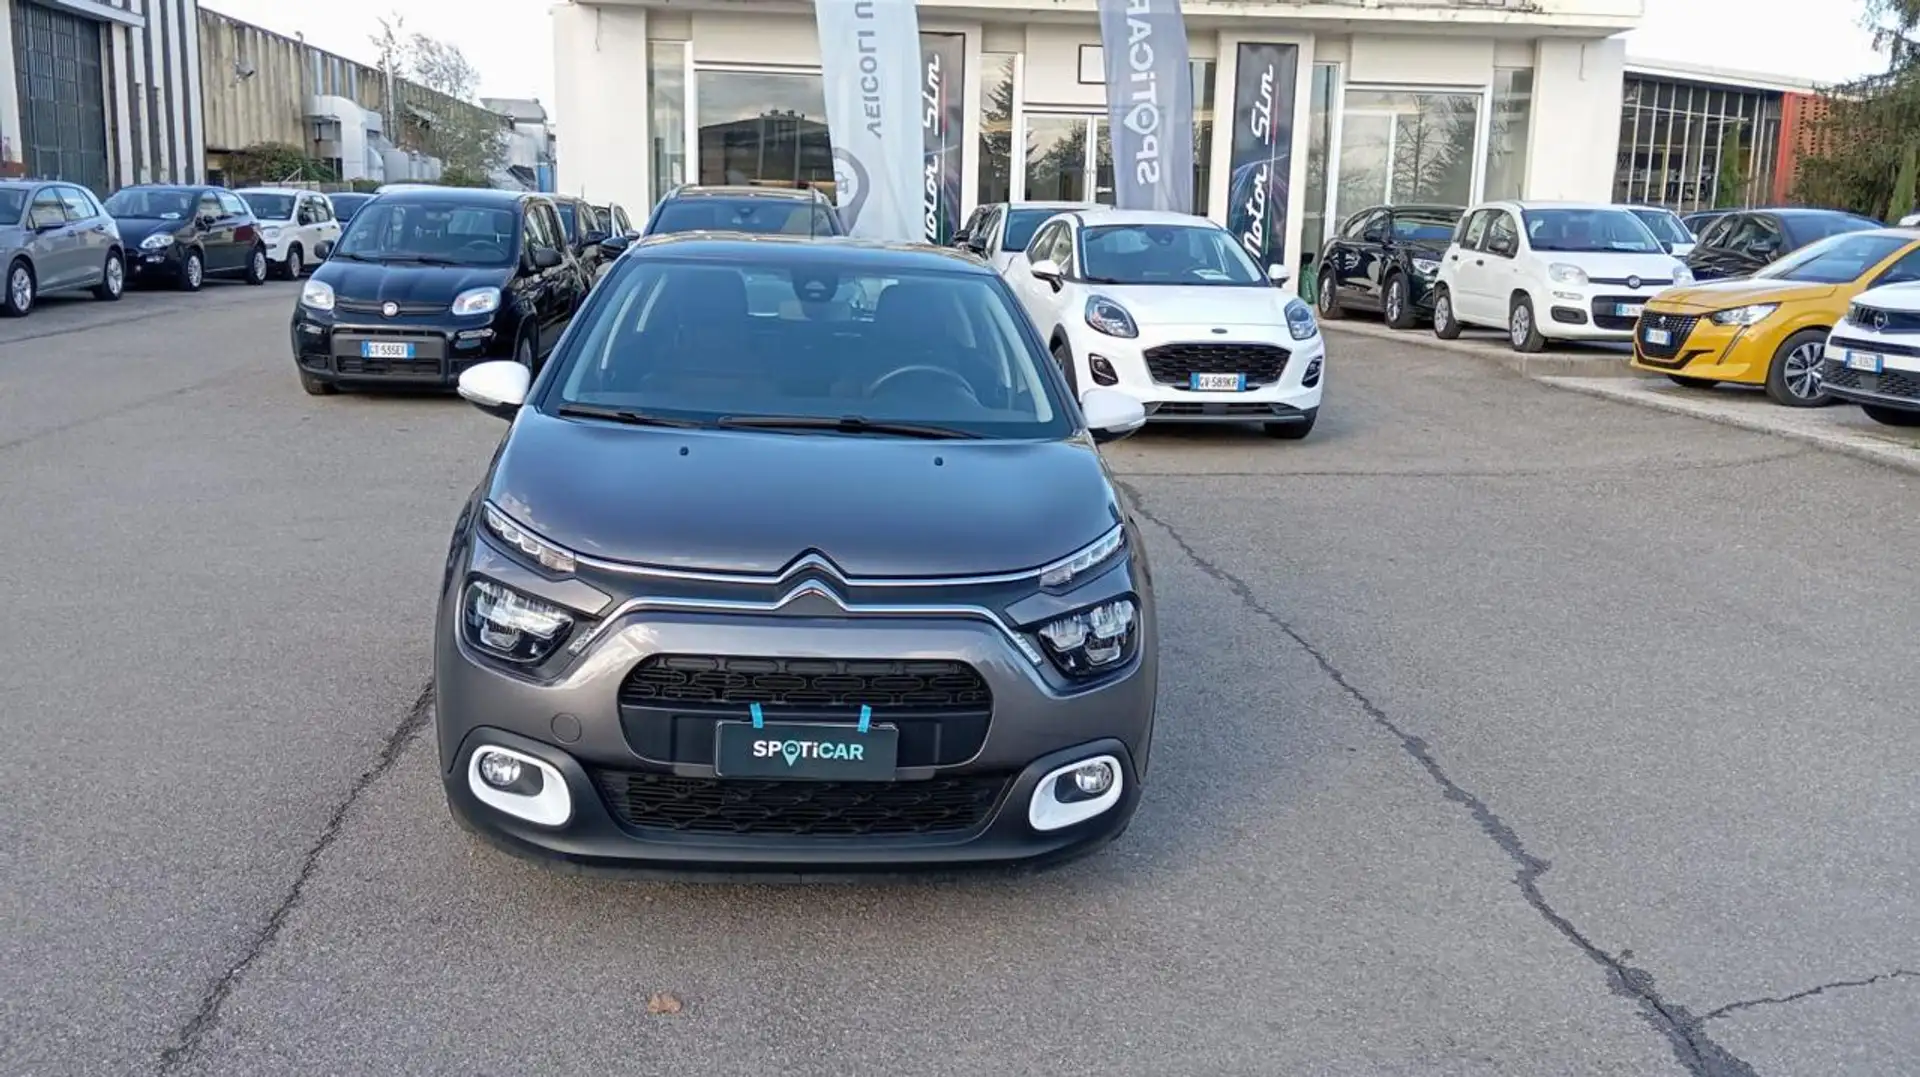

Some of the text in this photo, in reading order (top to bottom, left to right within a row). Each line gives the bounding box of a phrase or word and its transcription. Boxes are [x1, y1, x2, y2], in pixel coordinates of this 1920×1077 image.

[923, 53, 940, 136] Sim
[1243, 64, 1274, 258] Motor Sim
[752, 740, 864, 767] SPOTiCAR
